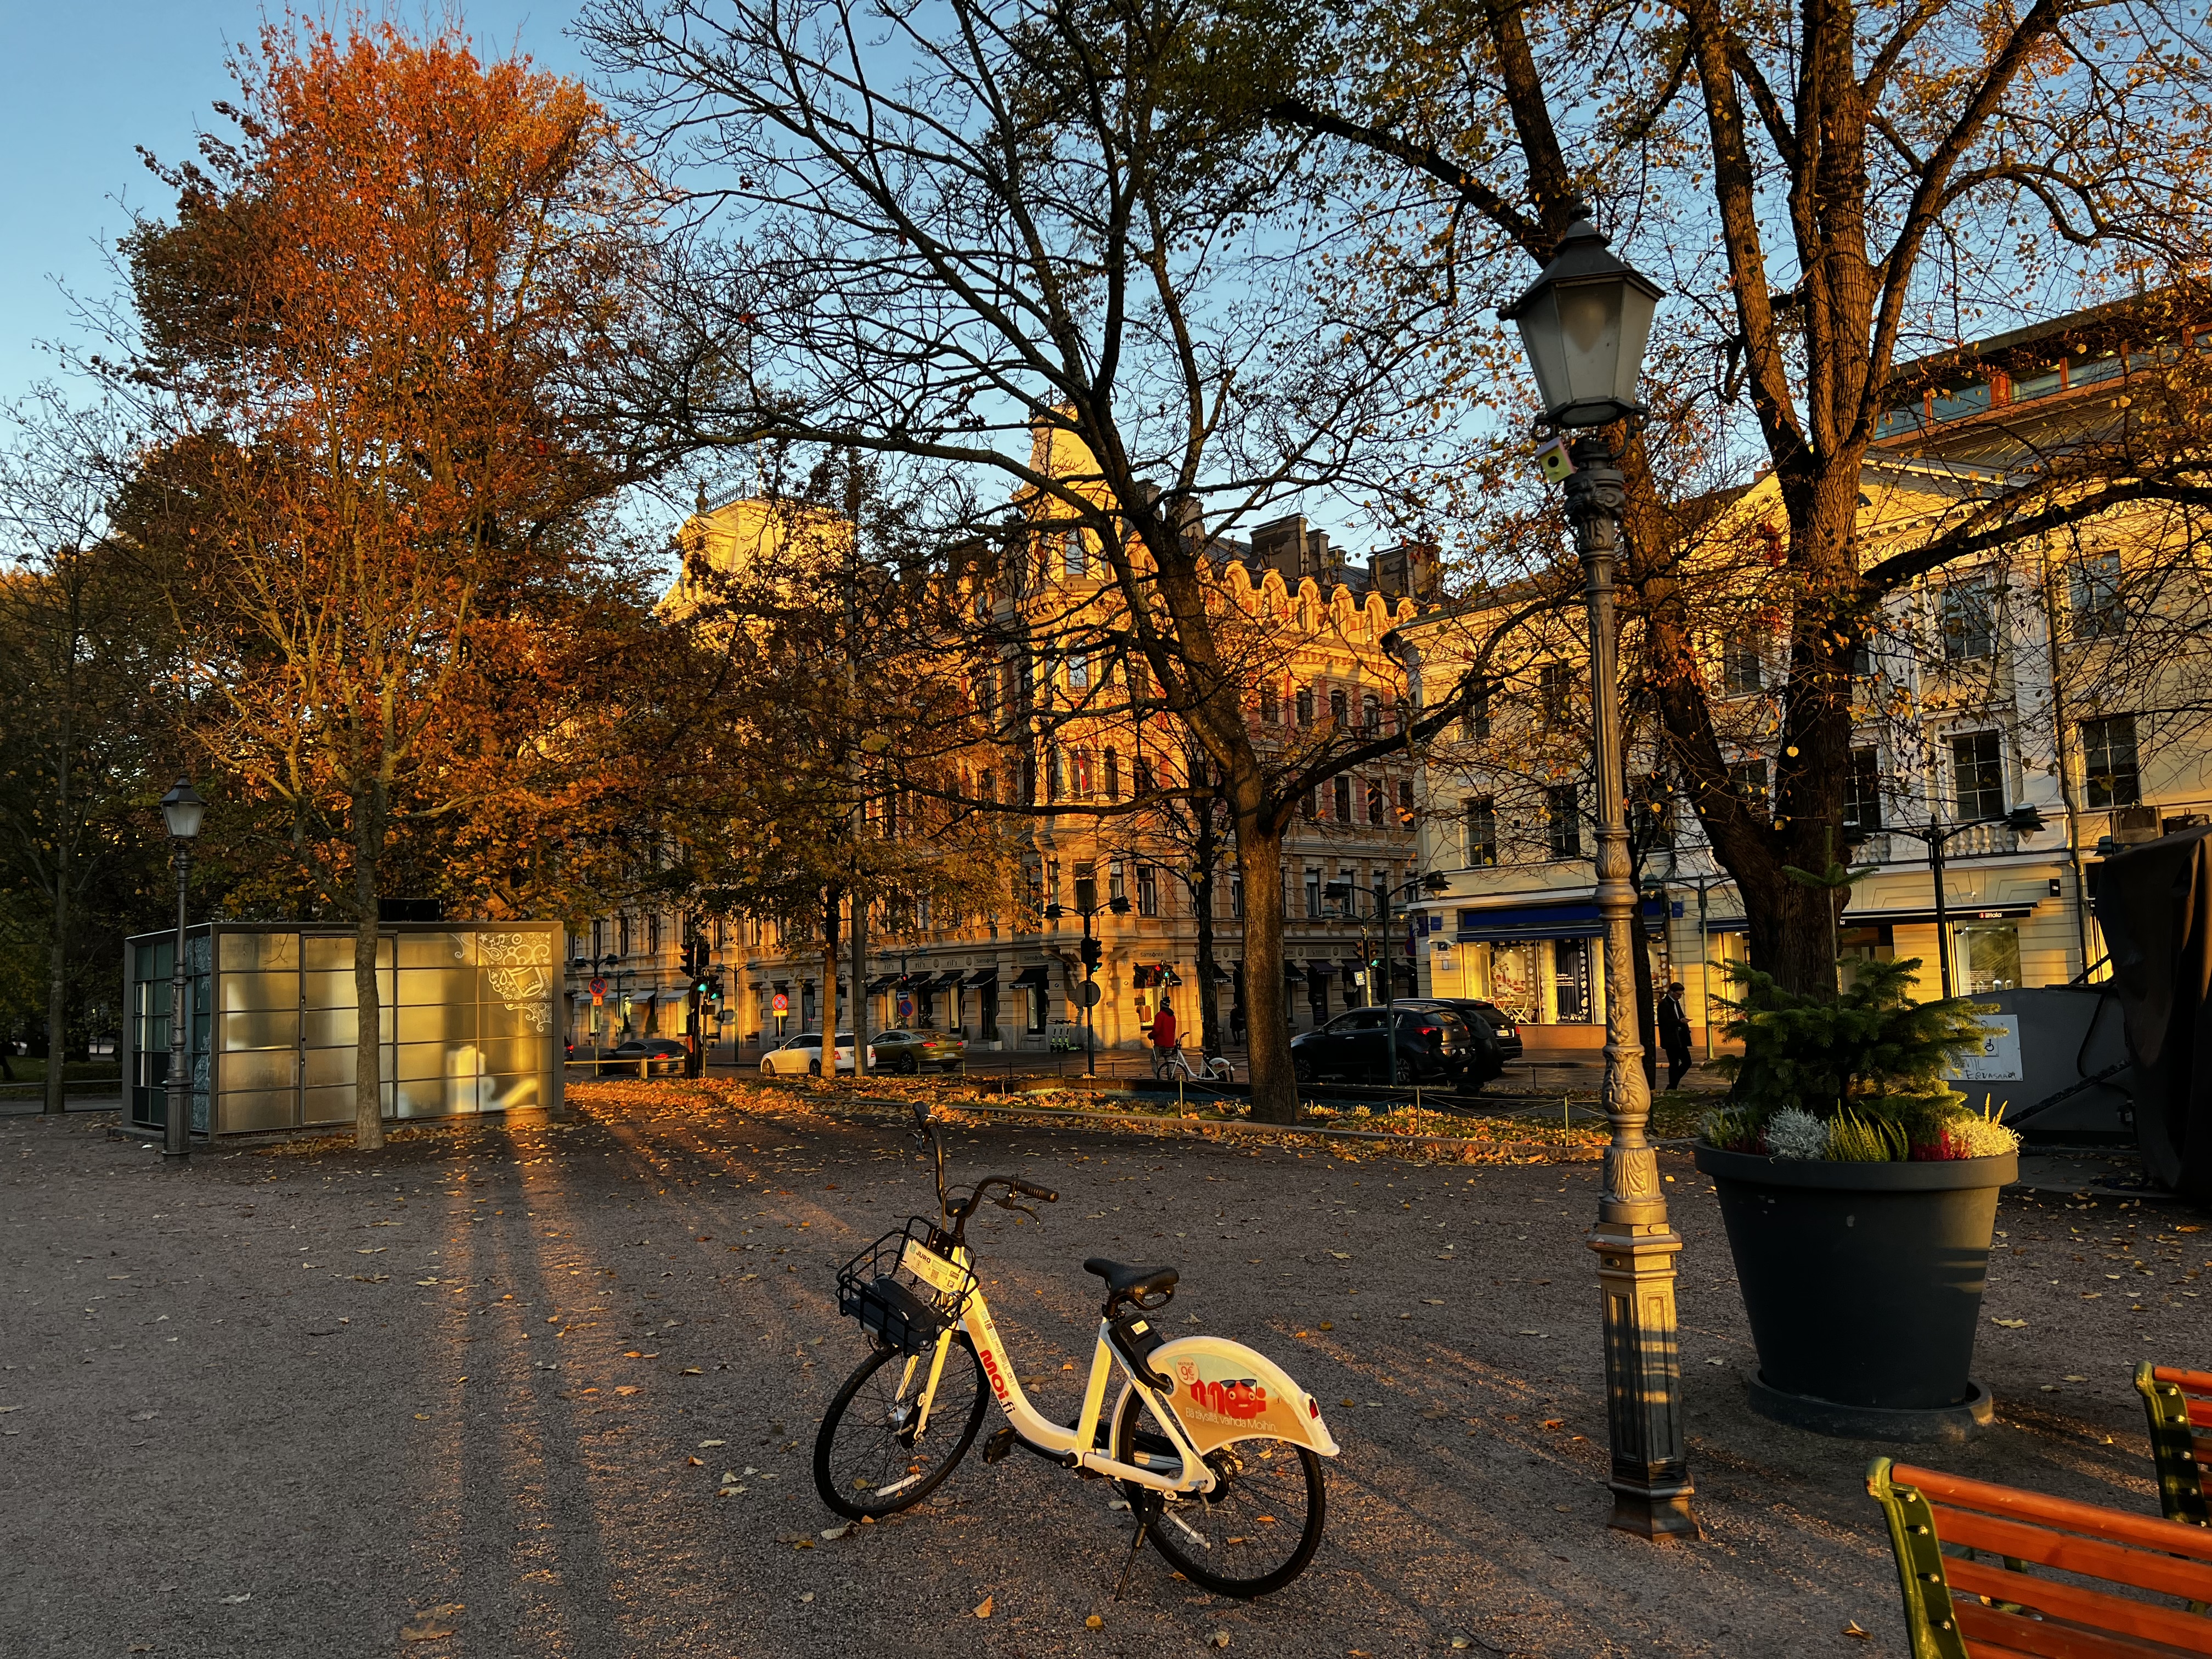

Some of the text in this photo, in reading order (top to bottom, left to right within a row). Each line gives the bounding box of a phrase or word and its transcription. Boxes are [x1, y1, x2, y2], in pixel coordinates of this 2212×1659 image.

[916, 1250, 931, 1263] JURO
[1181, 1365, 1195, 1380] 9€
[1186, 1407, 1278, 1432] Elä täysillä, vaihda Moihin.
